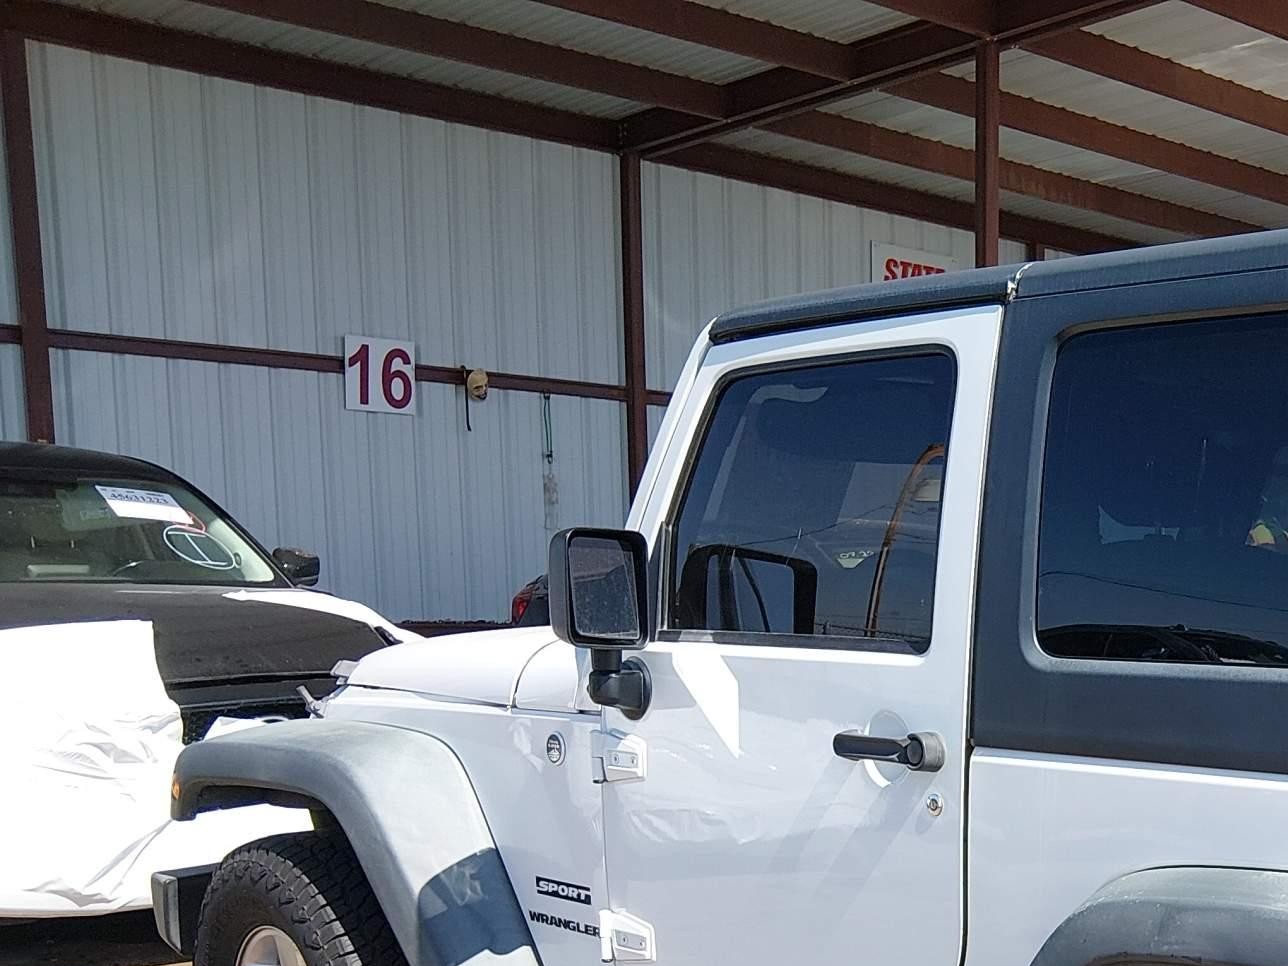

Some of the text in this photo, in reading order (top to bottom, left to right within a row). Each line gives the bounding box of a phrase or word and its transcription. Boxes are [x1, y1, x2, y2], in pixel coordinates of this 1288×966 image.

[348, 344, 412, 409] 16
[537, 880, 592, 901] SPORT
[529, 910, 600, 938] WRANGLER
